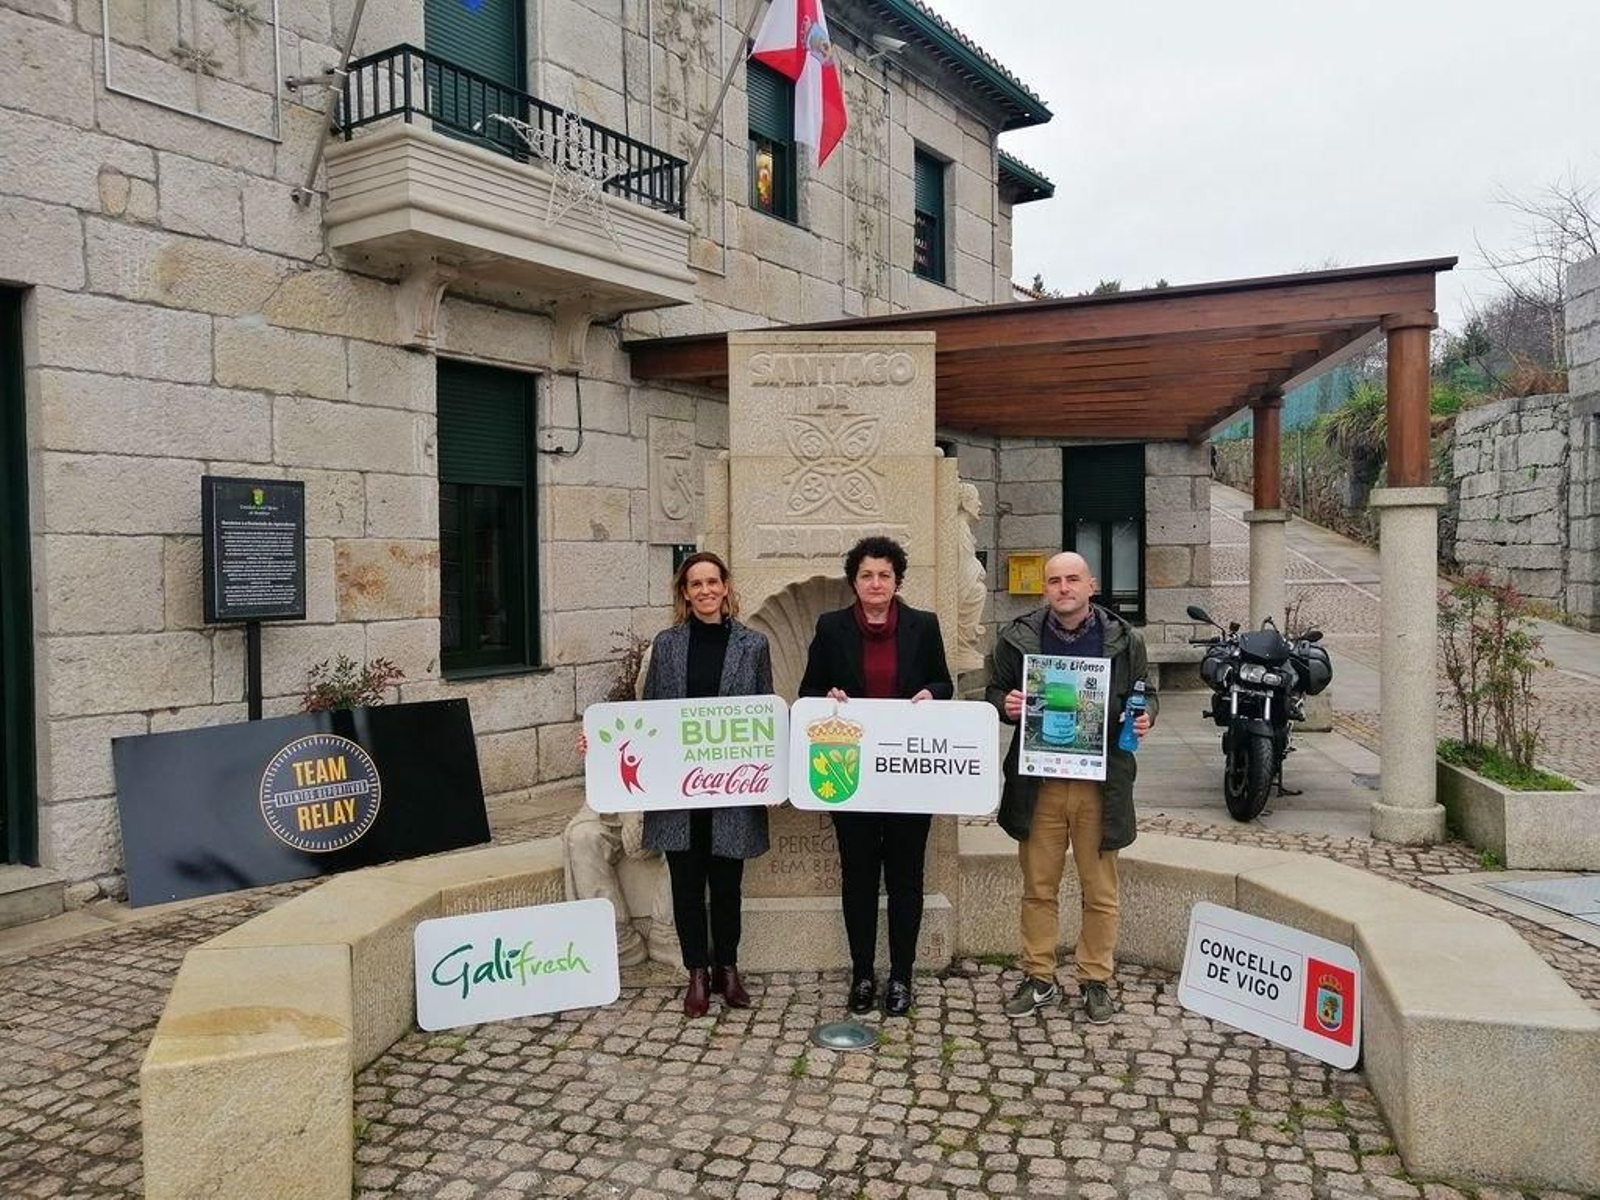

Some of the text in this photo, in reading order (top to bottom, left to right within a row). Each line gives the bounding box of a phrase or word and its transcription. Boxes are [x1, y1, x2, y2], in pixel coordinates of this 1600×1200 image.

[749, 351, 917, 387] SANTIAGO
[816, 386, 850, 410] DE
[680, 703, 774, 718] EVENTOS CON
[681, 717, 775, 745] BUEN
[906, 737, 948, 753] ELM
[683, 744, 775, 763] AMBIENTE
[875, 757, 981, 776] BEMBRIVE
[292, 755, 348, 787] TEAM
[682, 763, 773, 797] Coca-Cola
[297, 798, 356, 832] RELAY
[778, 835, 836, 853] PEREG
[432, 937, 591, 1000] Galifresh
[1200, 938, 1293, 982] CONCELLO
[1207, 962, 1279, 1001] DE VIGO
